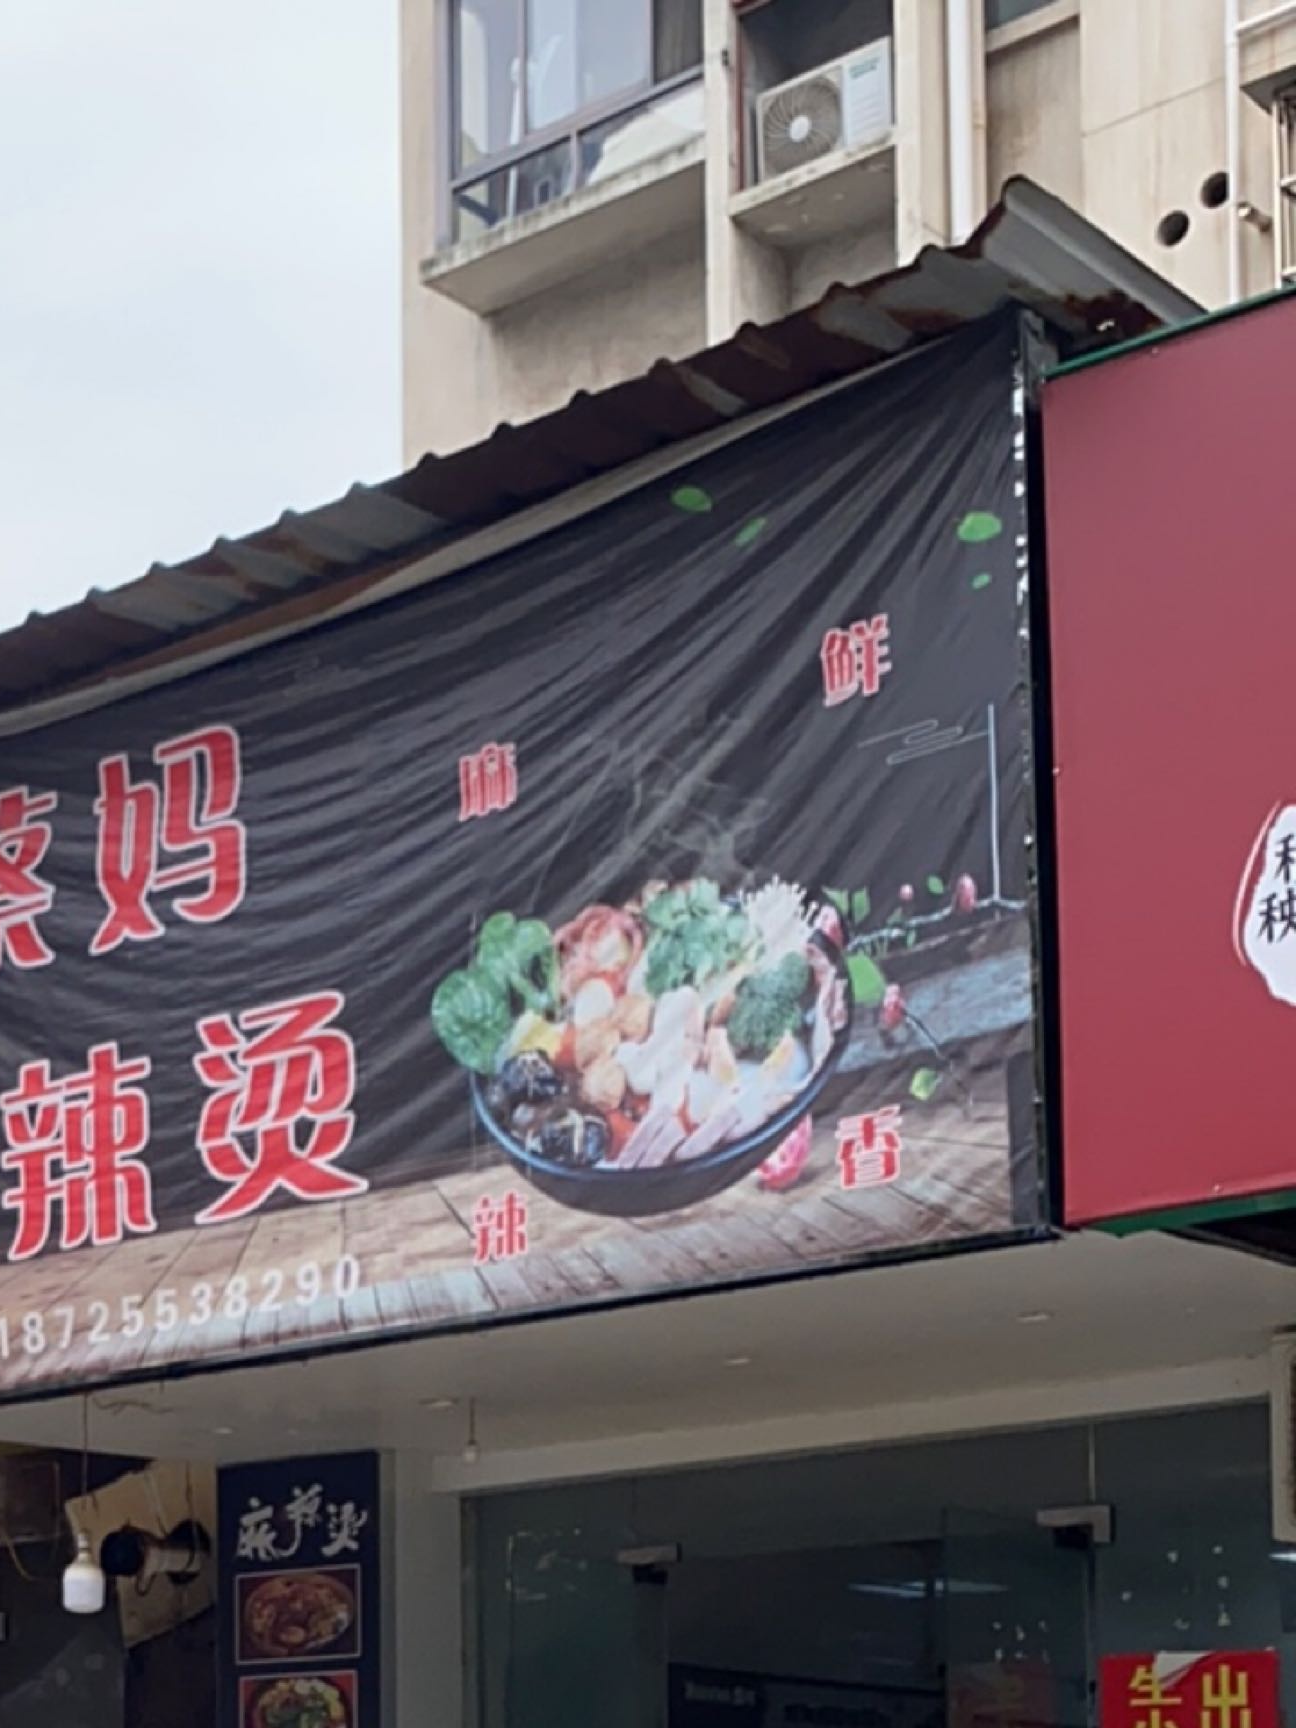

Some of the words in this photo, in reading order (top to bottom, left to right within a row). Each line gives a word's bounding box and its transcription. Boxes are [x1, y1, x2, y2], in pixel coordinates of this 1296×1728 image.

[820, 611, 892, 706] 鲜
[459, 741, 517, 823] 麻
[835, 1103, 903, 1189] 香
[474, 1190, 527, 1266] 辣
